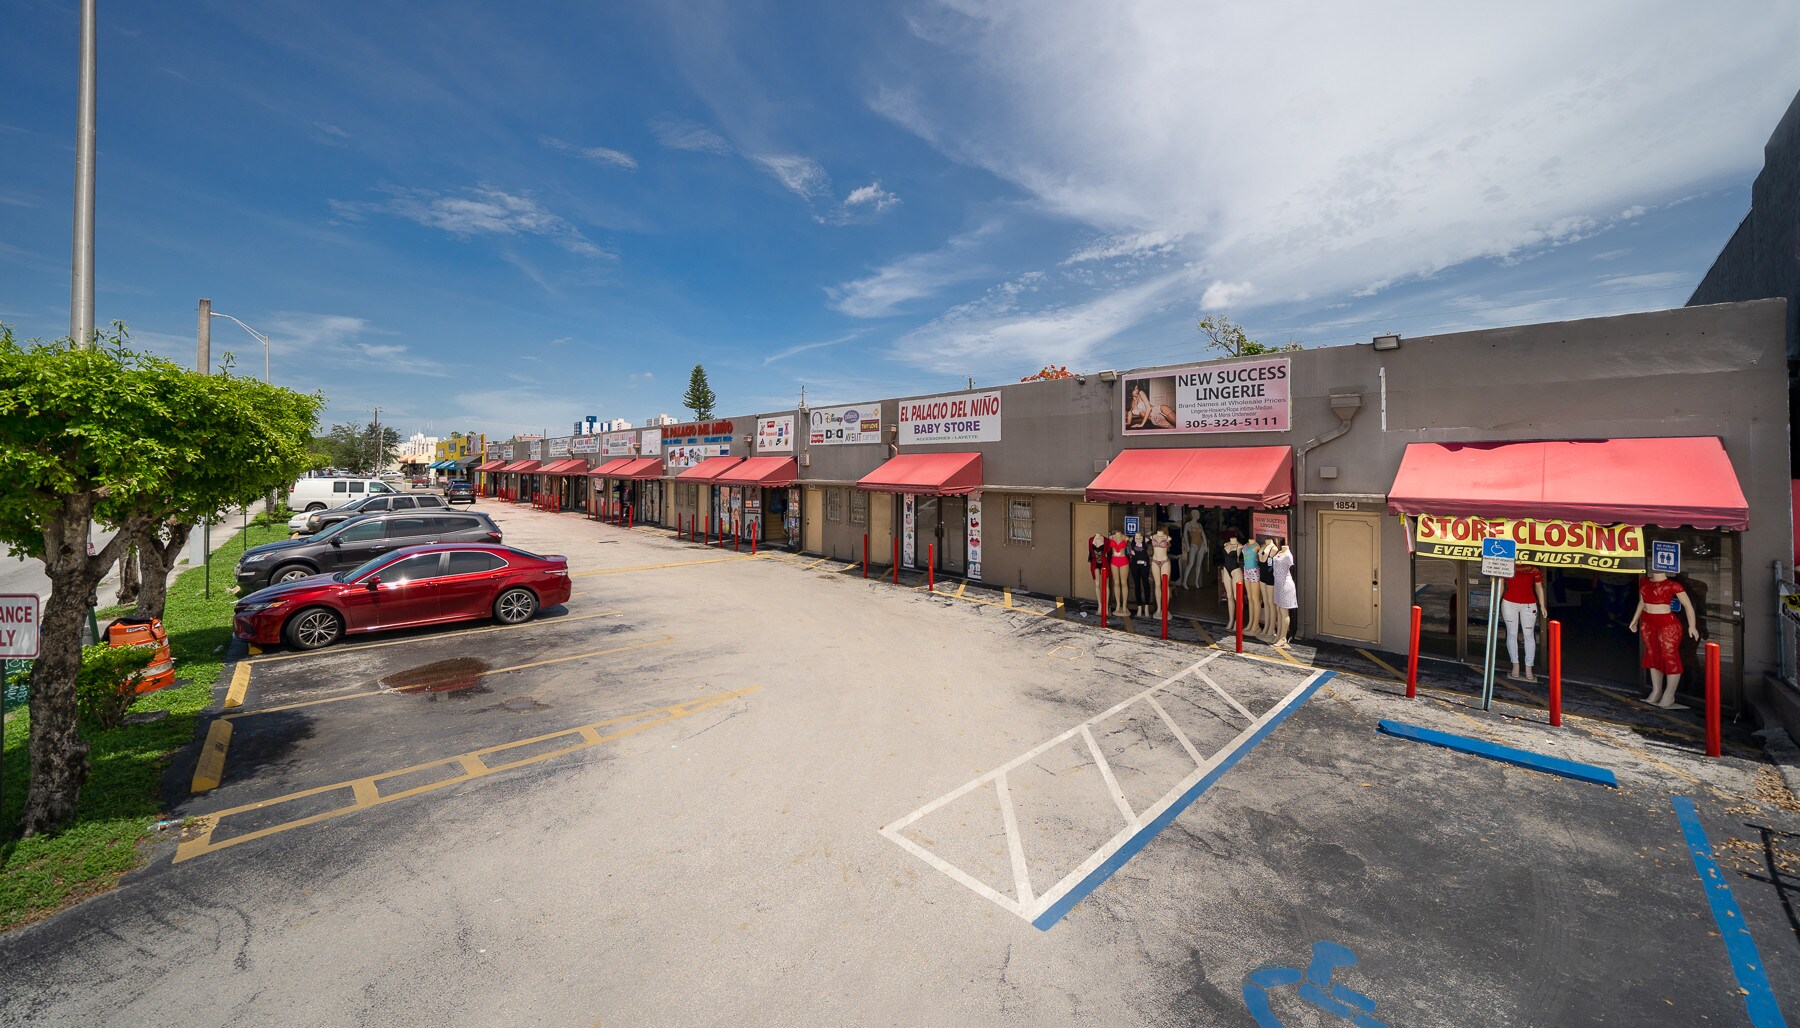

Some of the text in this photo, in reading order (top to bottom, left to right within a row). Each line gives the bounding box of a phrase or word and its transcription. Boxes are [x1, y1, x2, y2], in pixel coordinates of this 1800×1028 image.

[1178, 365, 1287, 387] NEW SUCCESS
[1196, 384, 1265, 400] LINGERIE
[900, 395, 1000, 422] EL PALACIO DEL NIÑO
[914, 421, 980, 434] BABY STORE
[1185, 417, 1278, 428] 305-324-5111
[1420, 518, 1639, 552] STORE CLOSING
[1534, 551, 1584, 564] MUST
[1588, 556, 1620, 568] GO!
